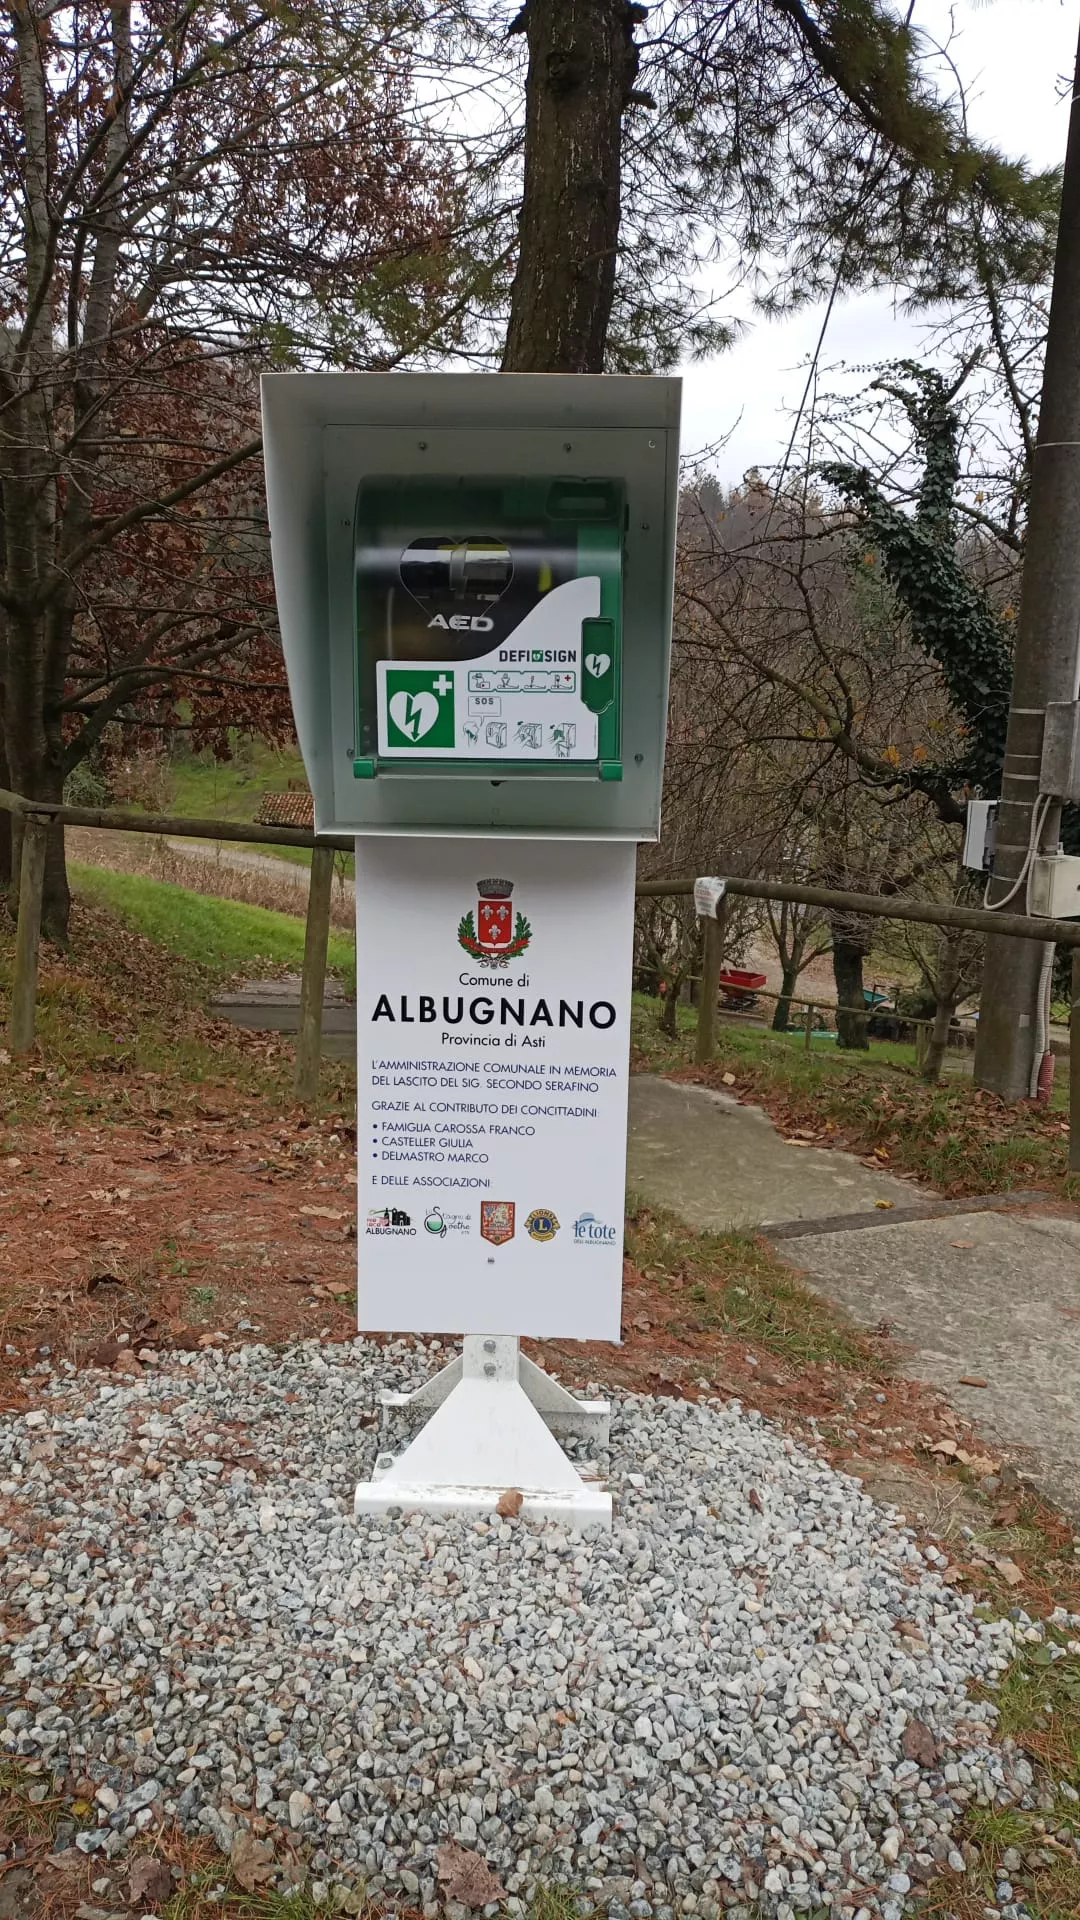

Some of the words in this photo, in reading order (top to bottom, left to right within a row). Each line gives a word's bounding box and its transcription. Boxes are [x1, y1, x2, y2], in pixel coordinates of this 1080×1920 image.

[427, 613, 495, 632] AED
[474, 697, 494, 706] SOS
[459, 972, 513, 988] Comune
[517, 973, 530, 988] di
[371, 993, 617, 1030] ALBUGNANO
[441, 1032, 501, 1048] Provincia
[504, 1033, 517, 1048] di
[521, 1034, 546, 1049] Asti
[371, 1060, 481, 1073] L'AMMINISTRAZIONE
[483, 1063, 546, 1075] COMUNALE
[549, 1065, 561, 1075] IN
[564, 1066, 617, 1078] MEMORIA
[371, 1076, 391, 1087] DEL
[393, 1076, 437, 1088] LASCITO
[440, 1077, 459, 1088] DEL
[486, 1079, 542, 1091] SECONDO
[545, 1081, 600, 1093] SERAFINO
[371, 1100, 411, 1112] GRAZIE
[413, 1102, 427, 1112] AL
[429, 1102, 499, 1115] CONTRIBUTO
[501, 1104, 518, 1115] DEI
[381, 1122, 432, 1133] FAMIGLIA
[434, 1123, 487, 1135] CAROSSA
[489, 1125, 536, 1137] FRANCO
[381, 1136, 436, 1148] CASTELLER
[438, 1138, 474, 1149] GIULIA
[381, 1151, 445, 1163] DELMASTRO
[447, 1153, 489, 1164] MARCO
[371, 1175, 378, 1185] E
[381, 1176, 409, 1186] DELLE
[365, 1228, 417, 1236] ALBUGNANO
[538, 1218, 548, 1231] L
[574, 1220, 586, 1238] le
[587, 1224, 617, 1240] tote
